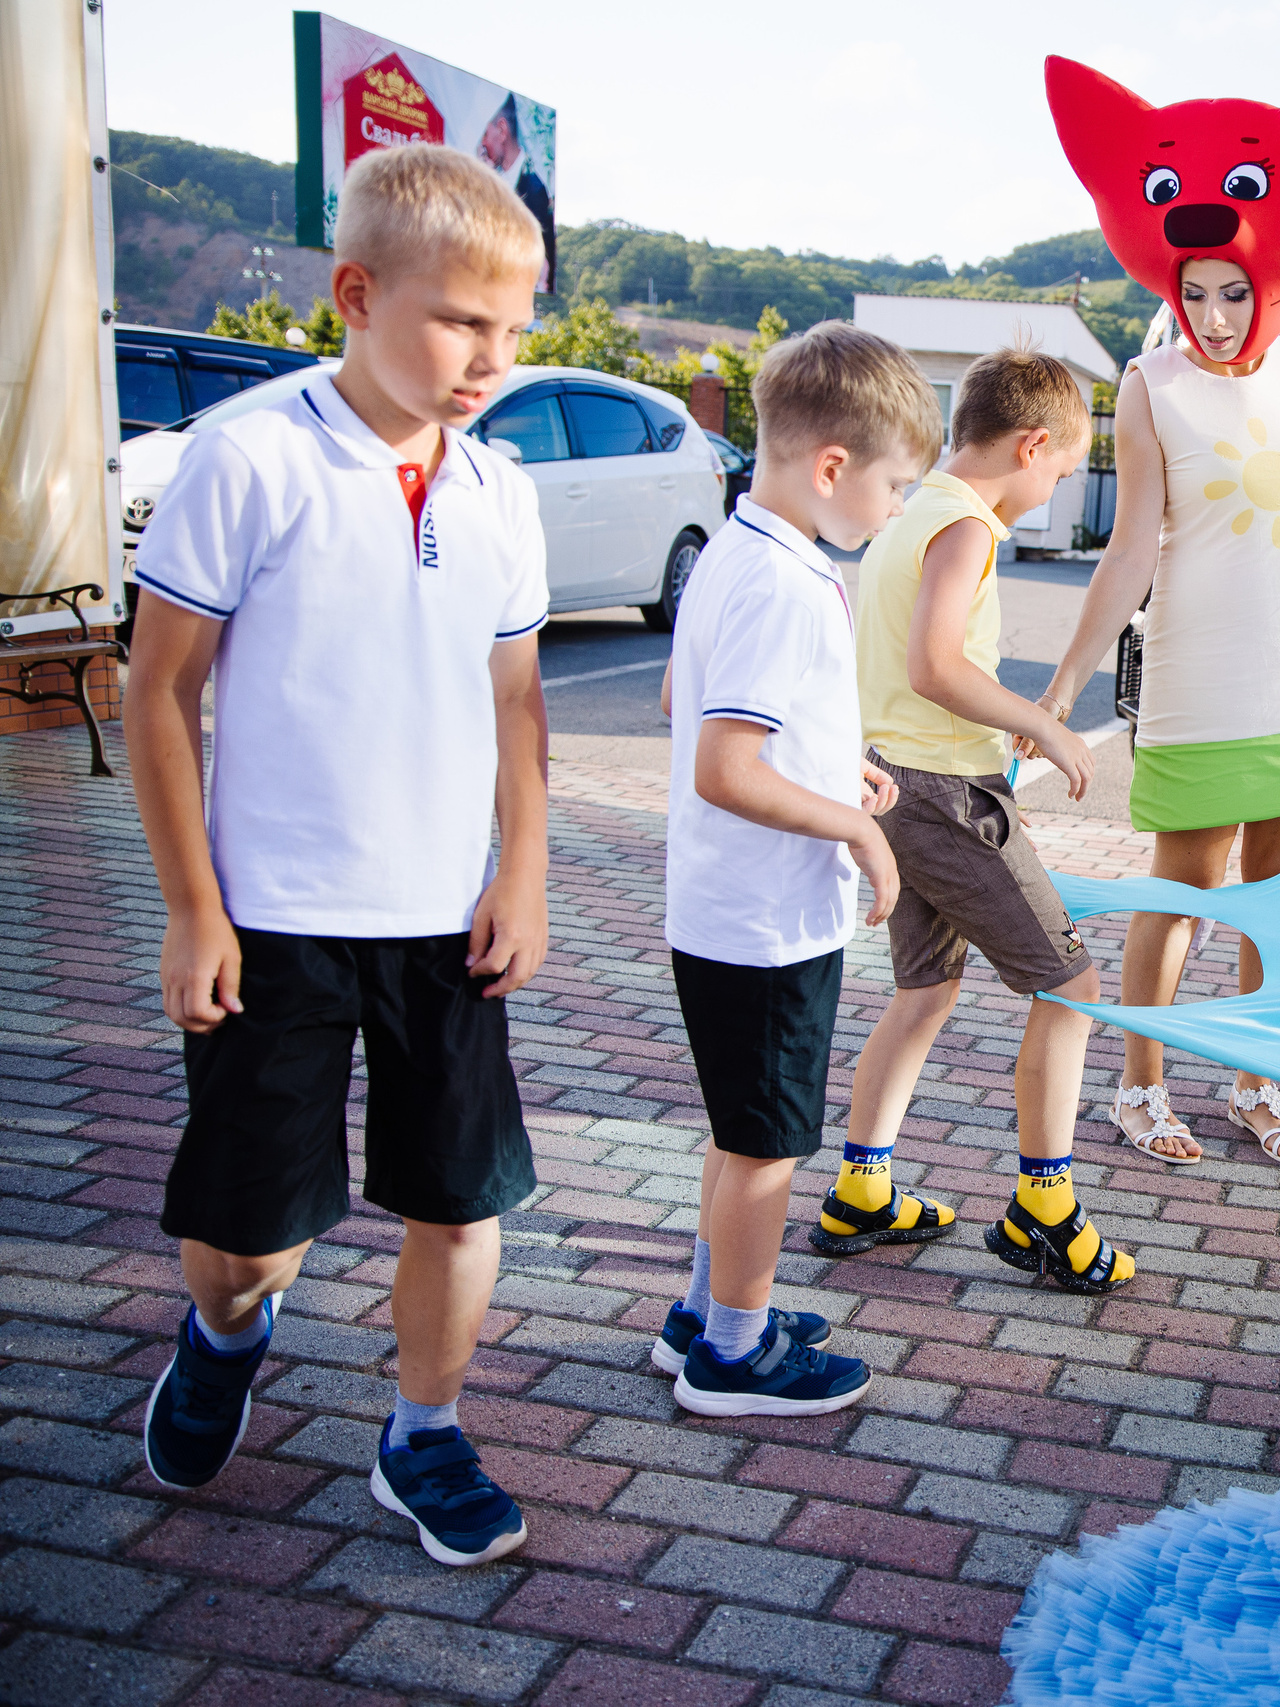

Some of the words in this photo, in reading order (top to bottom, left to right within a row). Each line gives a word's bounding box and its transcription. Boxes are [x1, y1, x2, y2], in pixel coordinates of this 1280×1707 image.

[854, 1153, 891, 1164] FILA
[850, 1165, 887, 1176] FILA
[1031, 1163, 1069, 1176] FILA
[1031, 1176, 1067, 1188] FILA
